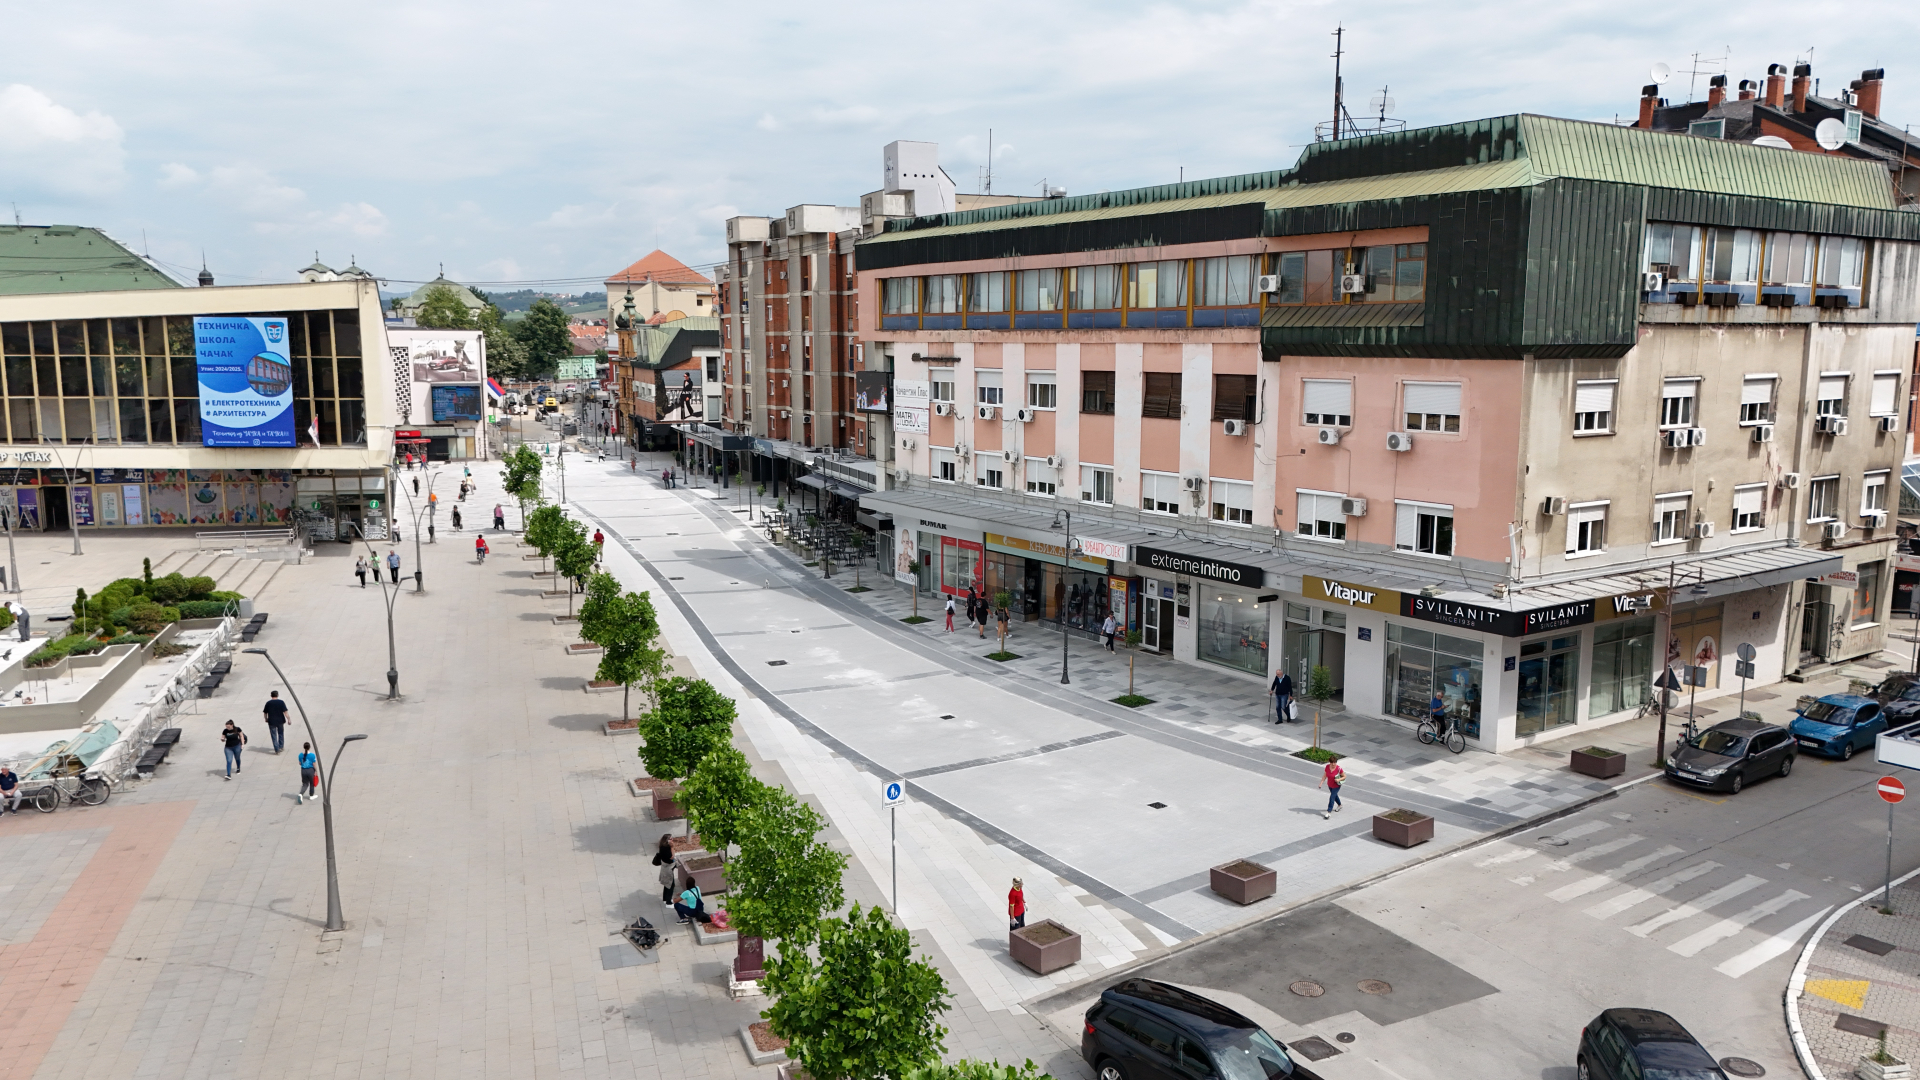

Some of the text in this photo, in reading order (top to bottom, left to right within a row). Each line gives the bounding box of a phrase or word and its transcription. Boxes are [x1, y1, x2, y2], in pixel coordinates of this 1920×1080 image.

[197, 322, 250, 331] ТЕХНИЧКА
[199, 336, 236, 344] ШКОЛА
[200, 350, 234, 358] ЧАЧАК
[14, 452, 51, 462] ЧАЧАК
[125, 471, 143, 479] JAZZ
[1828, 573, 1856, 582] AGENCIJA
[1322, 579, 1375, 605] Vitapur
[1415, 599, 1496, 623] SVILANIT
[1529, 604, 1587, 625] SVILANIT
